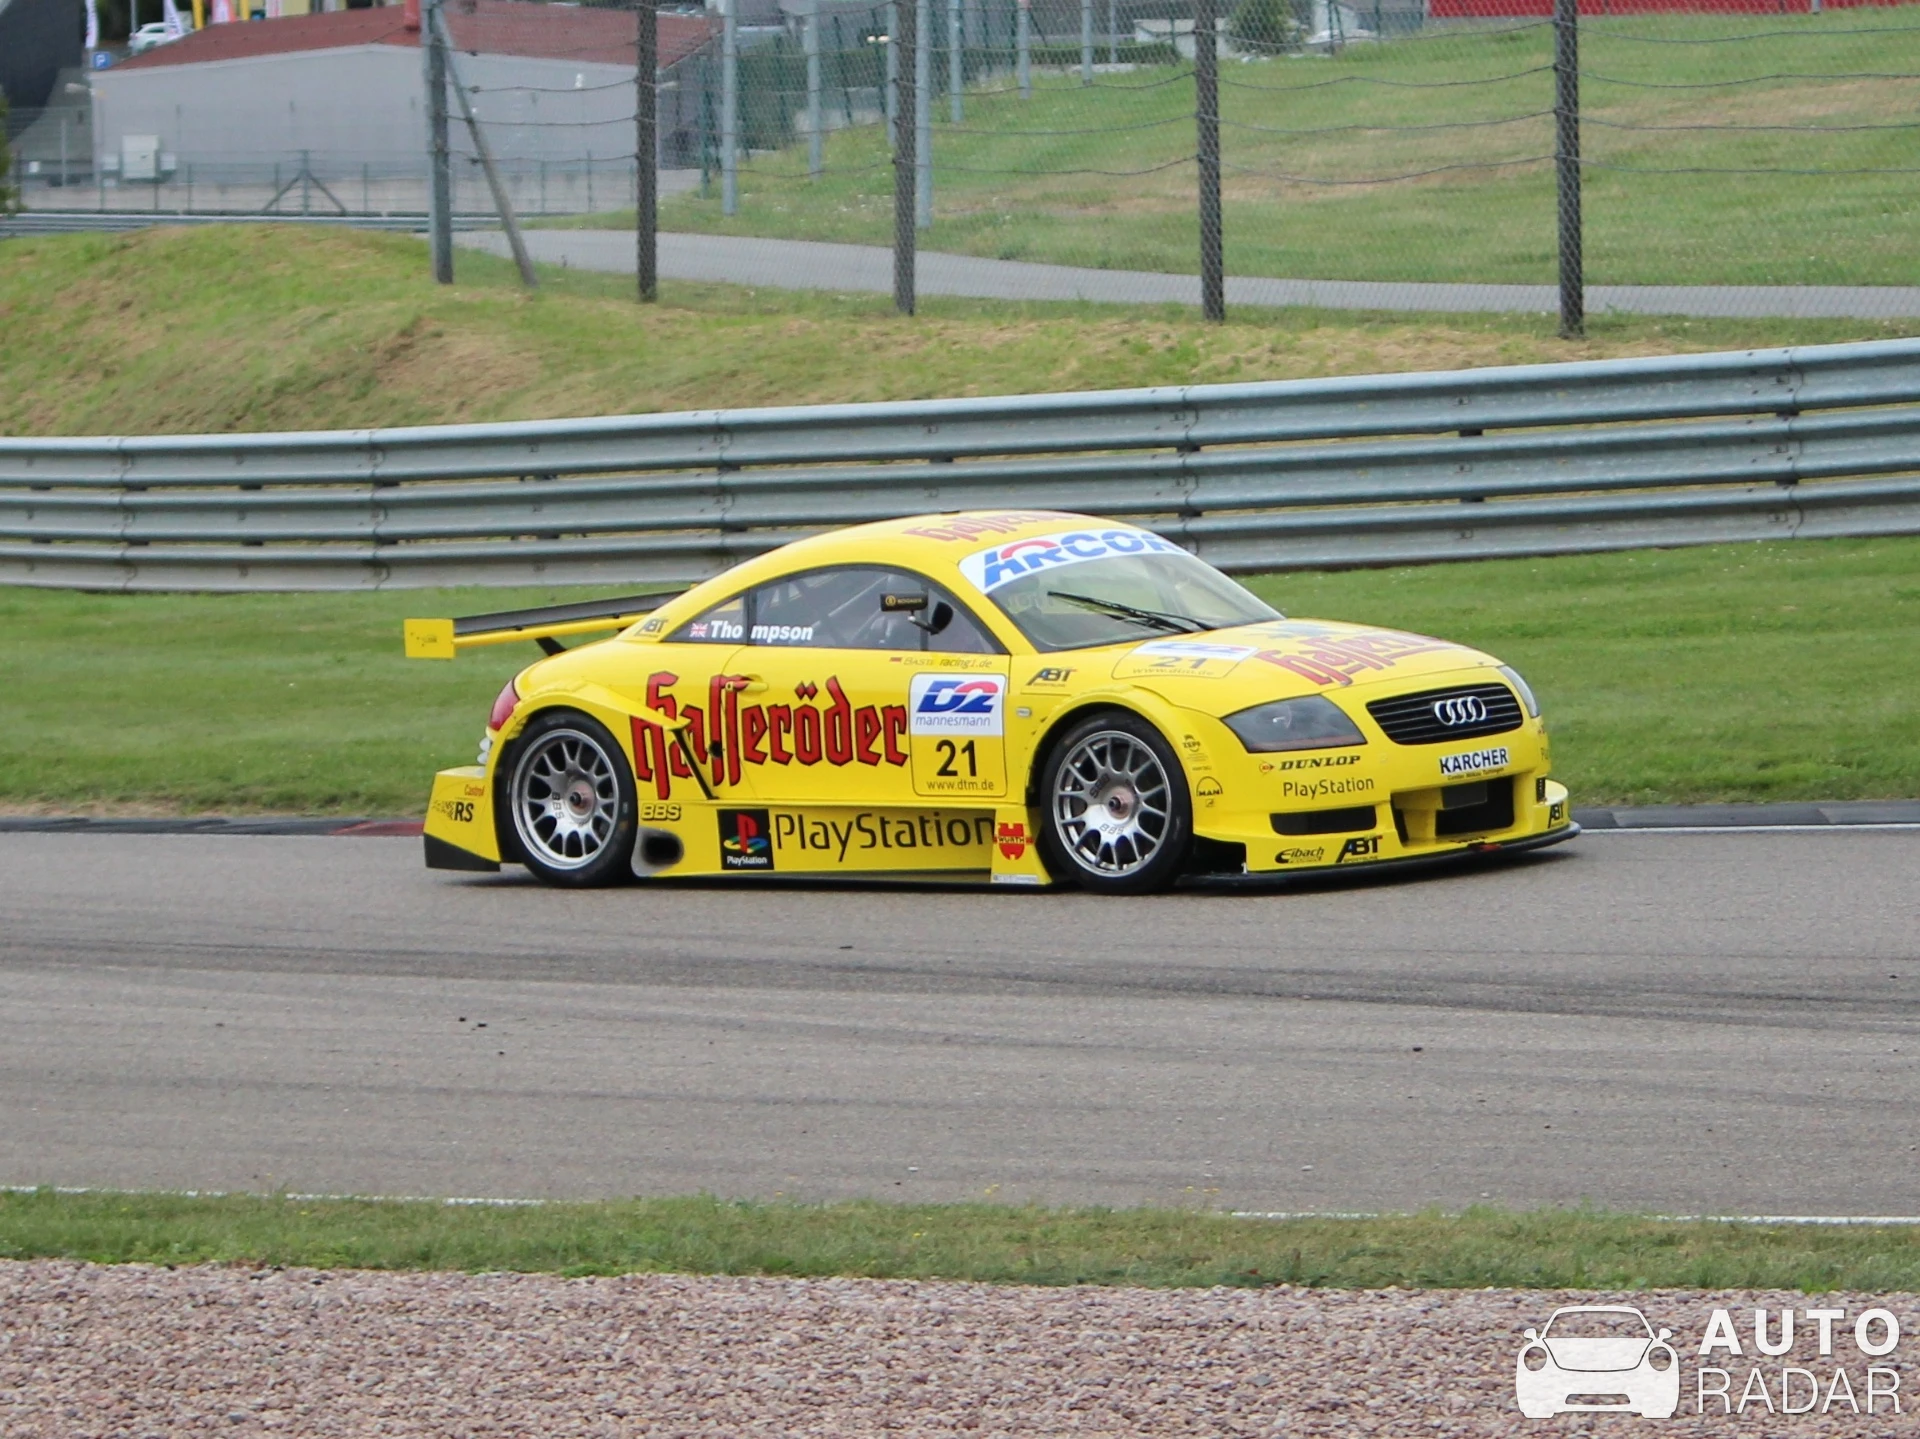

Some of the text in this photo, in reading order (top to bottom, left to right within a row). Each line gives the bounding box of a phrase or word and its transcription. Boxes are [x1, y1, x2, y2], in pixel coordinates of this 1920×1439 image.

[634, 618, 668, 637] ABT
[1150, 656, 1208, 669] 21
[1026, 667, 1078, 686] ABT
[916, 681, 999, 713] D2
[915, 716, 991, 727] mannesmann
[935, 739, 977, 777] 21
[1279, 755, 1361, 771] DUNLOP
[926, 778, 994, 791] www.dtm.de
[1198, 789, 1220, 797] MAN
[1283, 778, 1375, 800] PlayStation
[641, 803, 681, 821] BBS
[1548, 800, 1564, 829] ABT
[775, 811, 995, 863] PlayStation
[1275, 846, 1325, 864] Eibach
[1336, 835, 1383, 863] ABT
[726, 855, 768, 866] PlayStation
